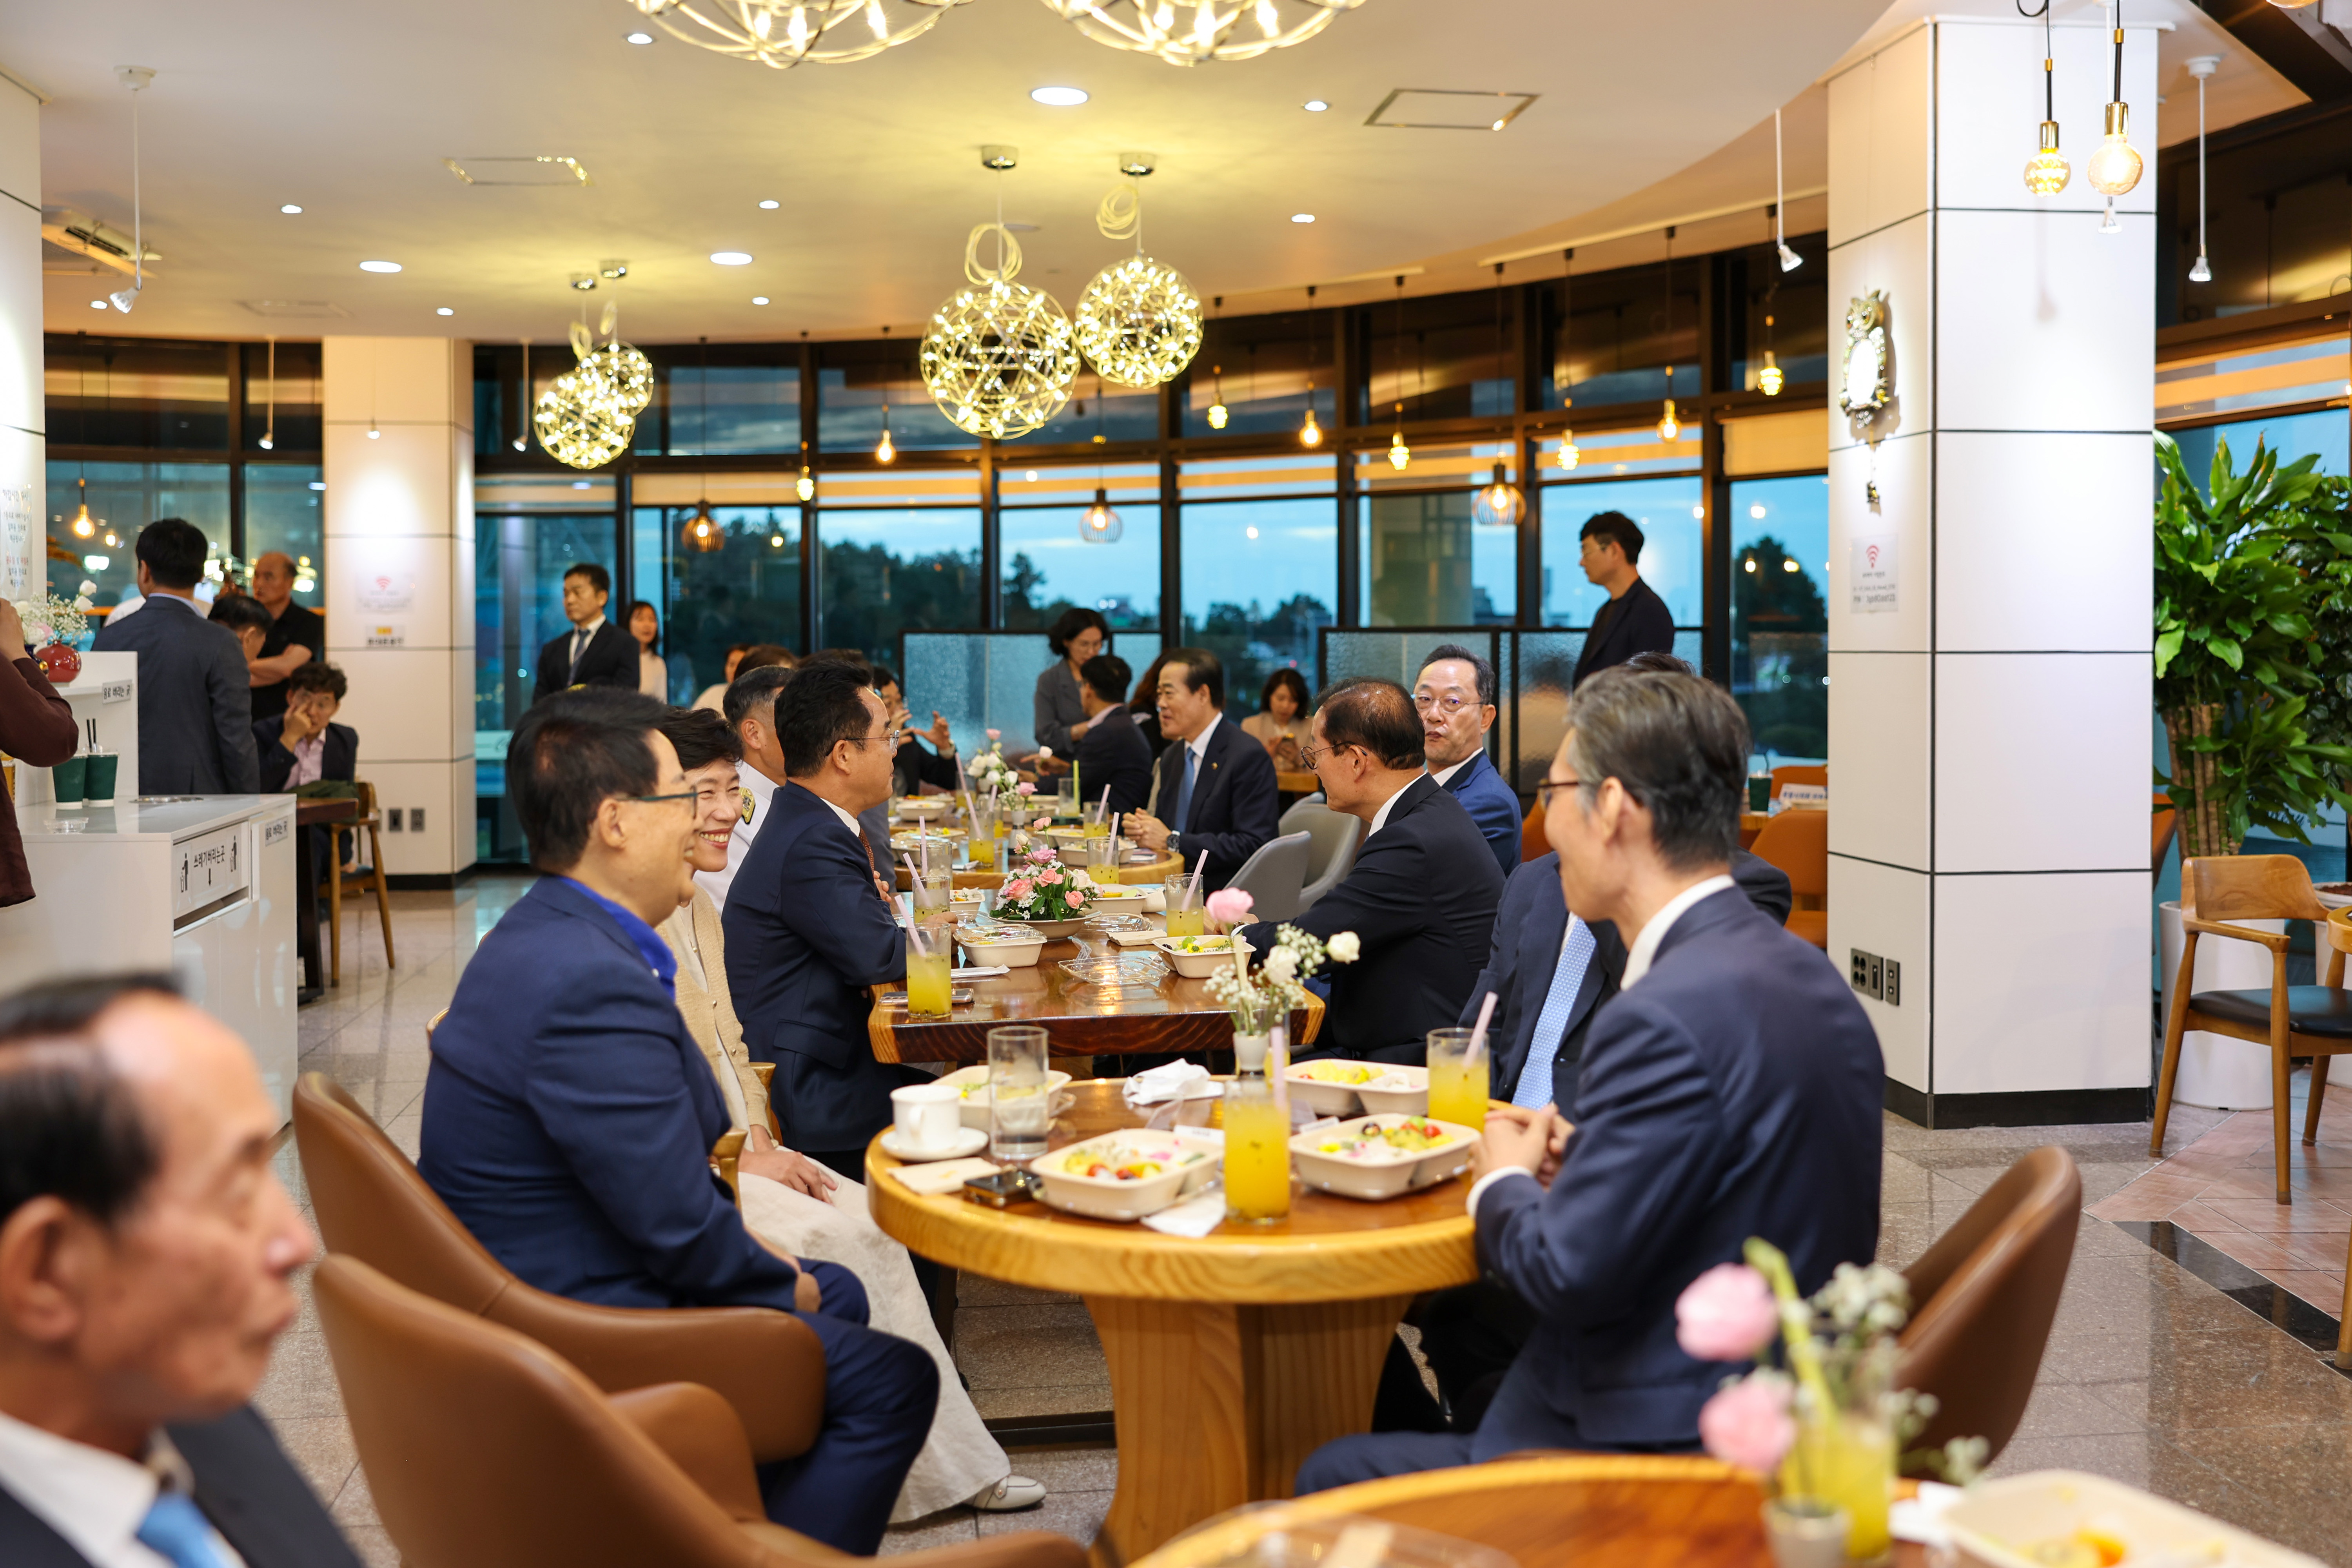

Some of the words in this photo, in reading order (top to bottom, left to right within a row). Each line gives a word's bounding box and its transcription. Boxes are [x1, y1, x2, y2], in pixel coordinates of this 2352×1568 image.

[104, 687, 111, 700] 음료
[113, 686, 124, 697] 버리는
[127, 684, 131, 696] 곳
[273, 824, 282, 836] 버리는
[194, 845, 225, 867] 쓰레기버리는곳
